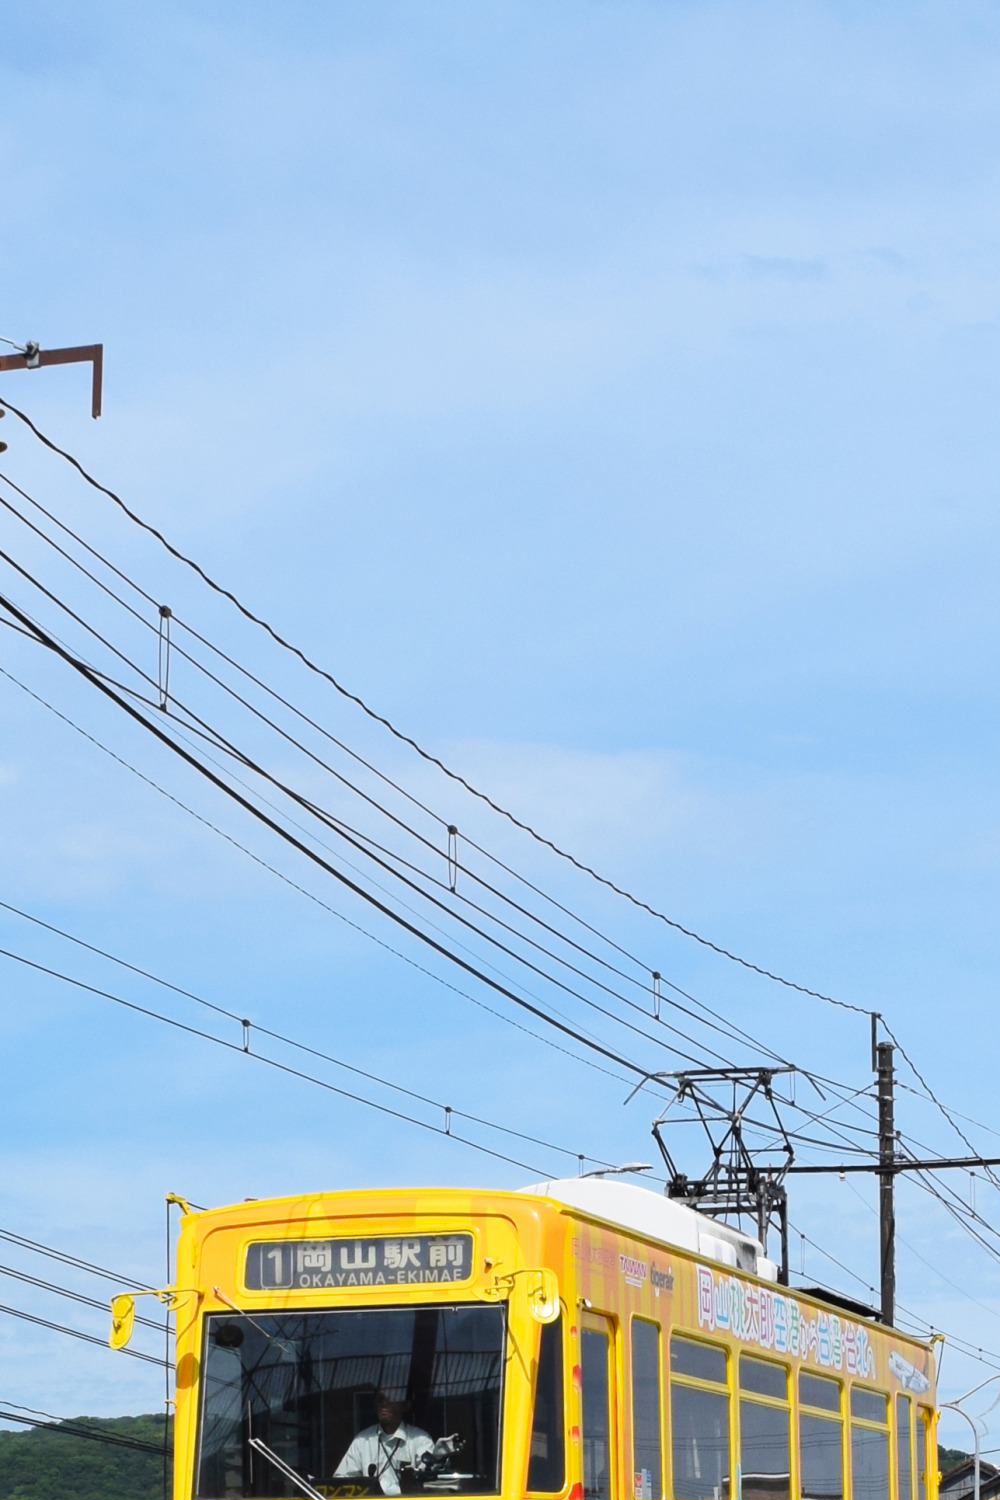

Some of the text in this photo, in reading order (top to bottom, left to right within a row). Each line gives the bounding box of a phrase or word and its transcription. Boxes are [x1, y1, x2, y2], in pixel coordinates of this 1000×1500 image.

[267, 1240, 464, 1284] 1 岡山駅前
[300, 1268, 463, 1288] OKAYAMA-EKIMAE
